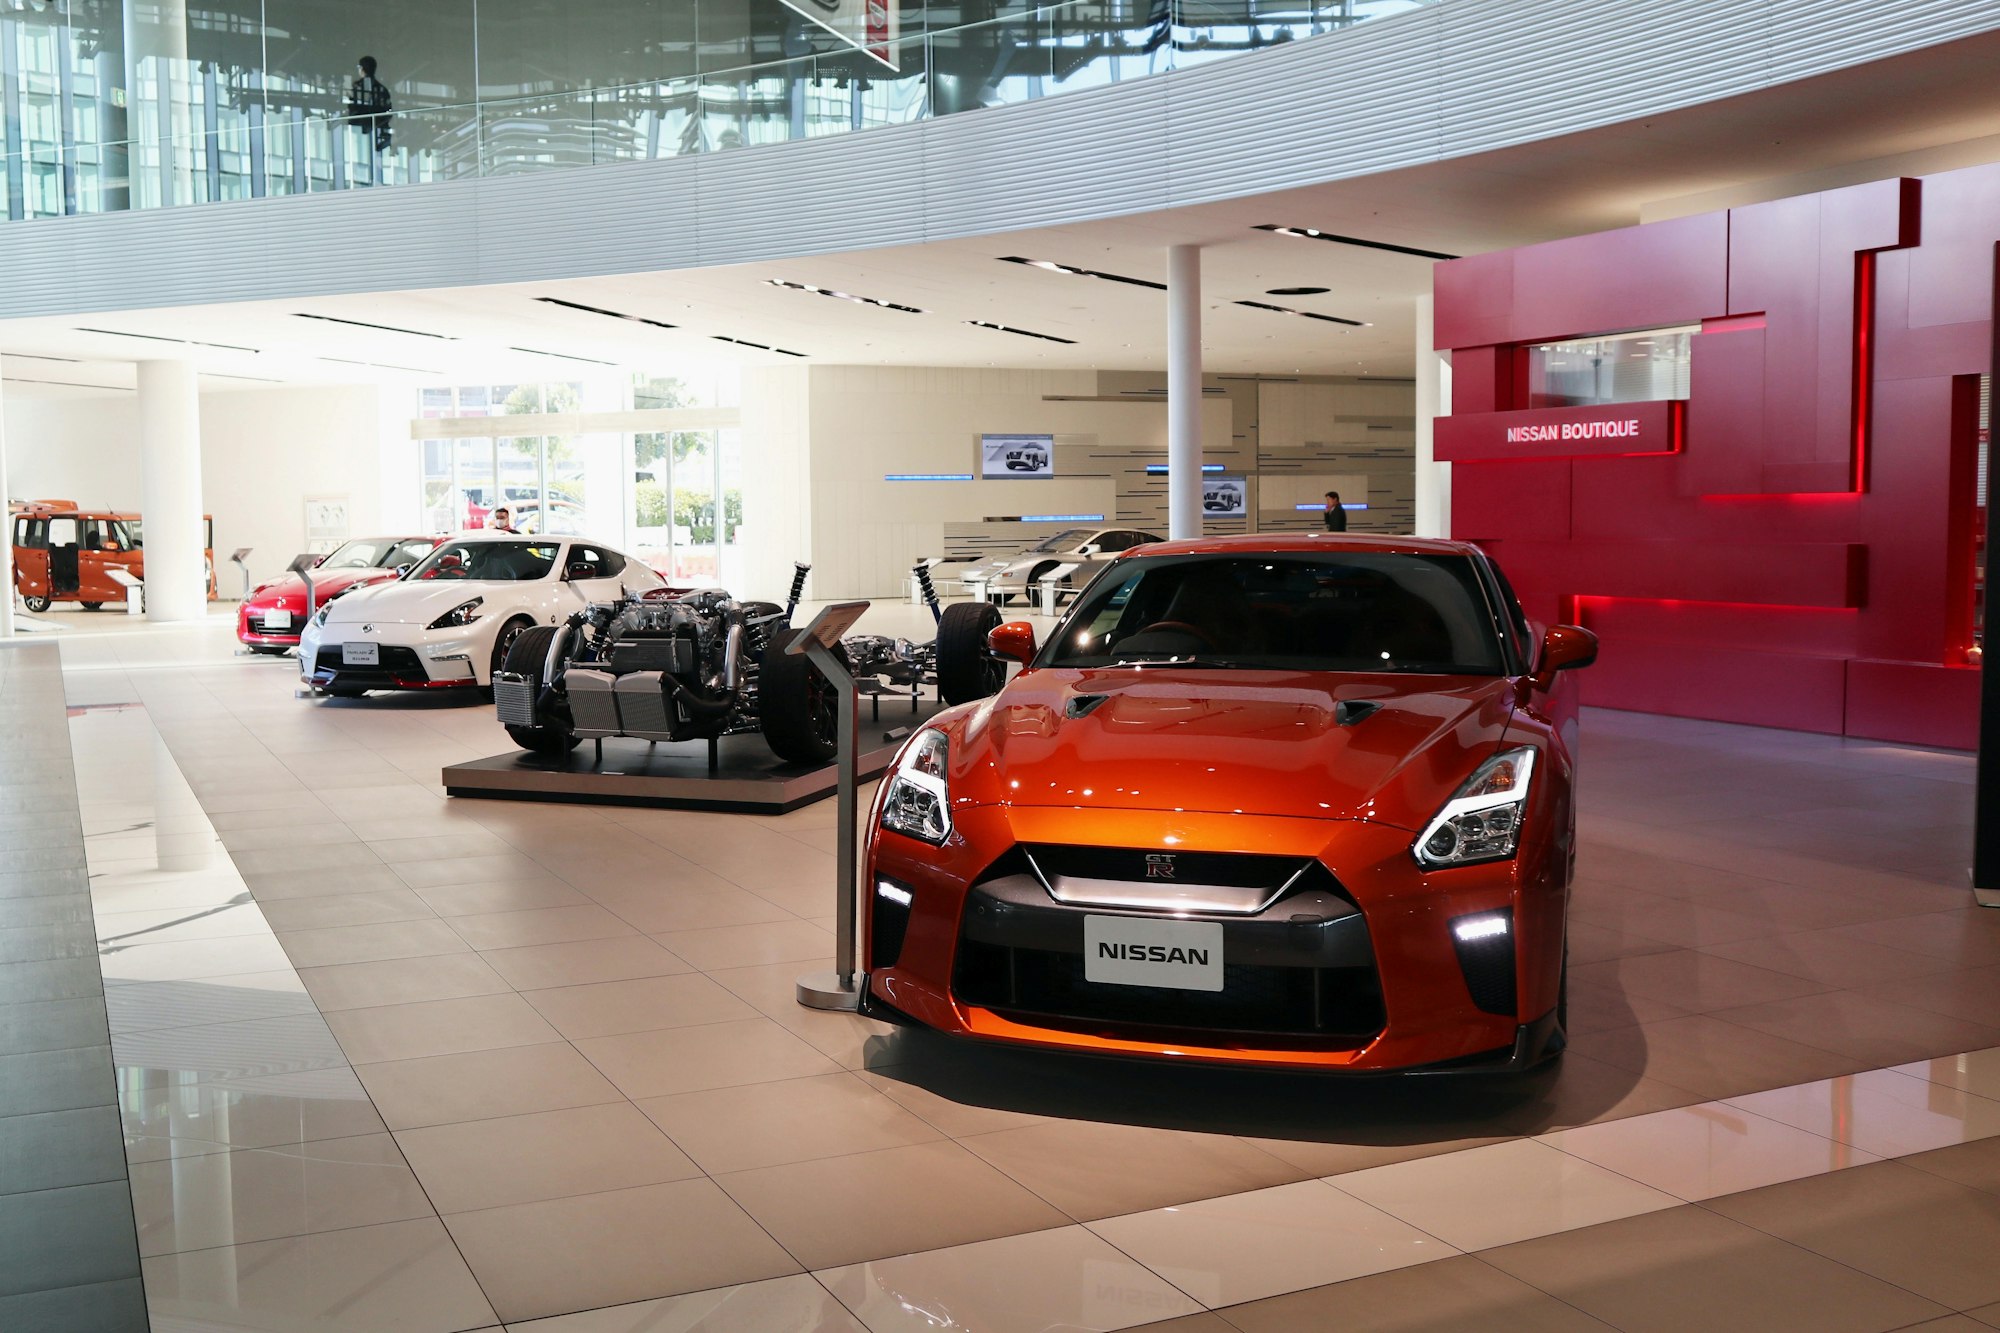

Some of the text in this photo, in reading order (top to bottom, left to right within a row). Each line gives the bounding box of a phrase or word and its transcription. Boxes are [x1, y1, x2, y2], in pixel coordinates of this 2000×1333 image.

[1507, 420, 1639, 443] NISSAN BOUTIQUE
[1145, 854, 1176, 862] GT
[1146, 862, 1176, 878] R
[1099, 942, 1208, 966] NISSAN
